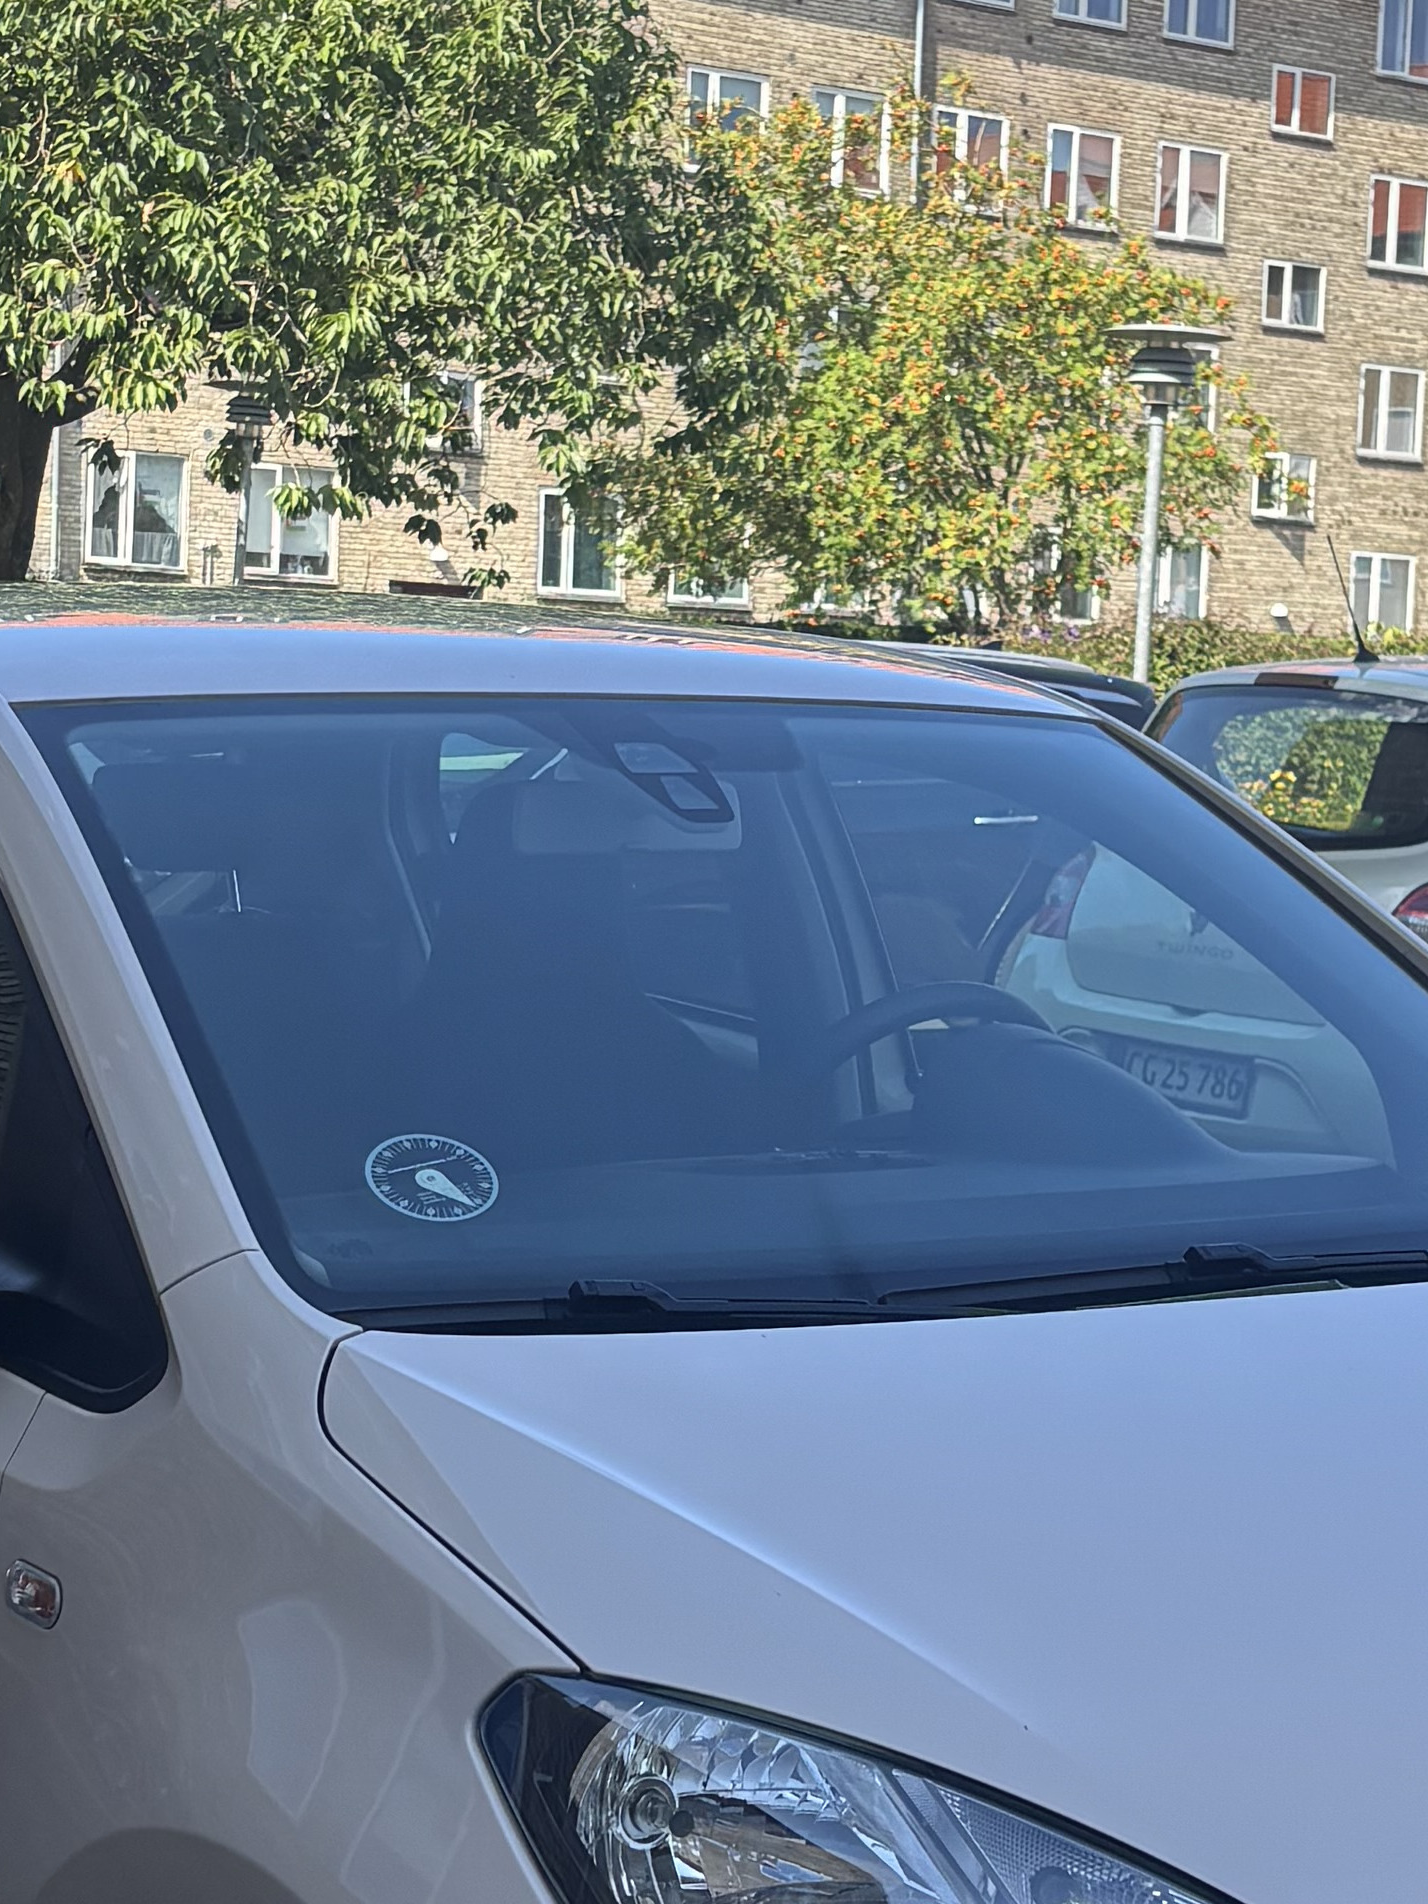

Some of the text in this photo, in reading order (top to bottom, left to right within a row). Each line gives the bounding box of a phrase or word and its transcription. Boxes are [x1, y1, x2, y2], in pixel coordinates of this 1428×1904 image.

[1126, 1050, 1244, 1102] CG 25 786
